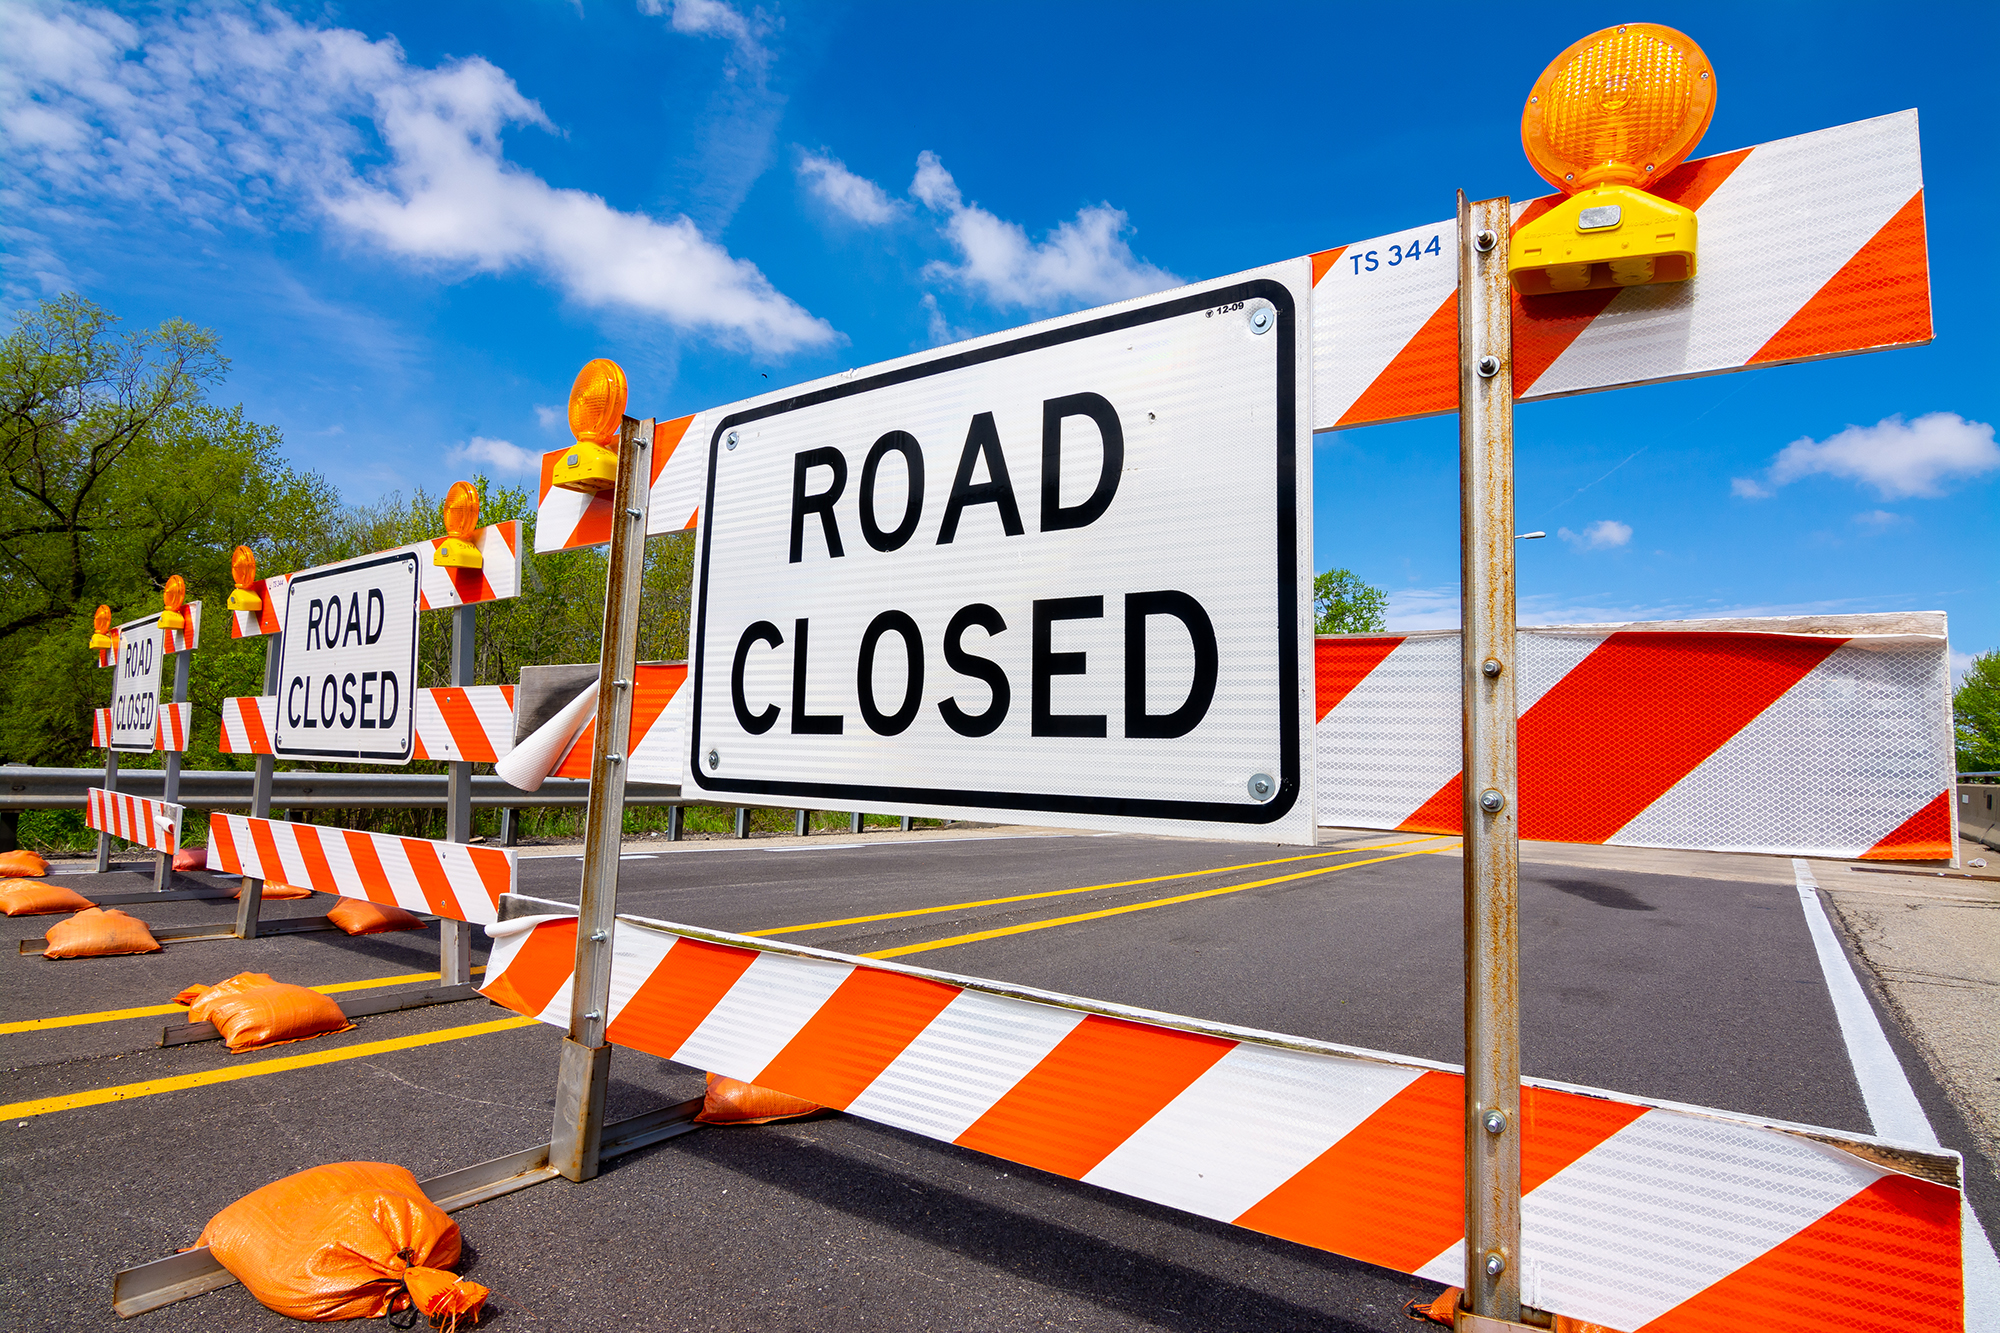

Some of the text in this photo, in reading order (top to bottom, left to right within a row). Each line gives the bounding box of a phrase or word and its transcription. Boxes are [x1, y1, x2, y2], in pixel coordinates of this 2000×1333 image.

[1350, 235, 1442, 276] TS 344
[1216, 301, 1245, 315] 12-09
[789, 391, 1125, 564] ROAD
[306, 588, 385, 652] ROAD
[124, 637, 153, 679] ROAD
[731, 590, 1219, 740] CLOSED
[116, 691, 154, 731] CLOSED
[287, 670, 399, 730] CLOSED
